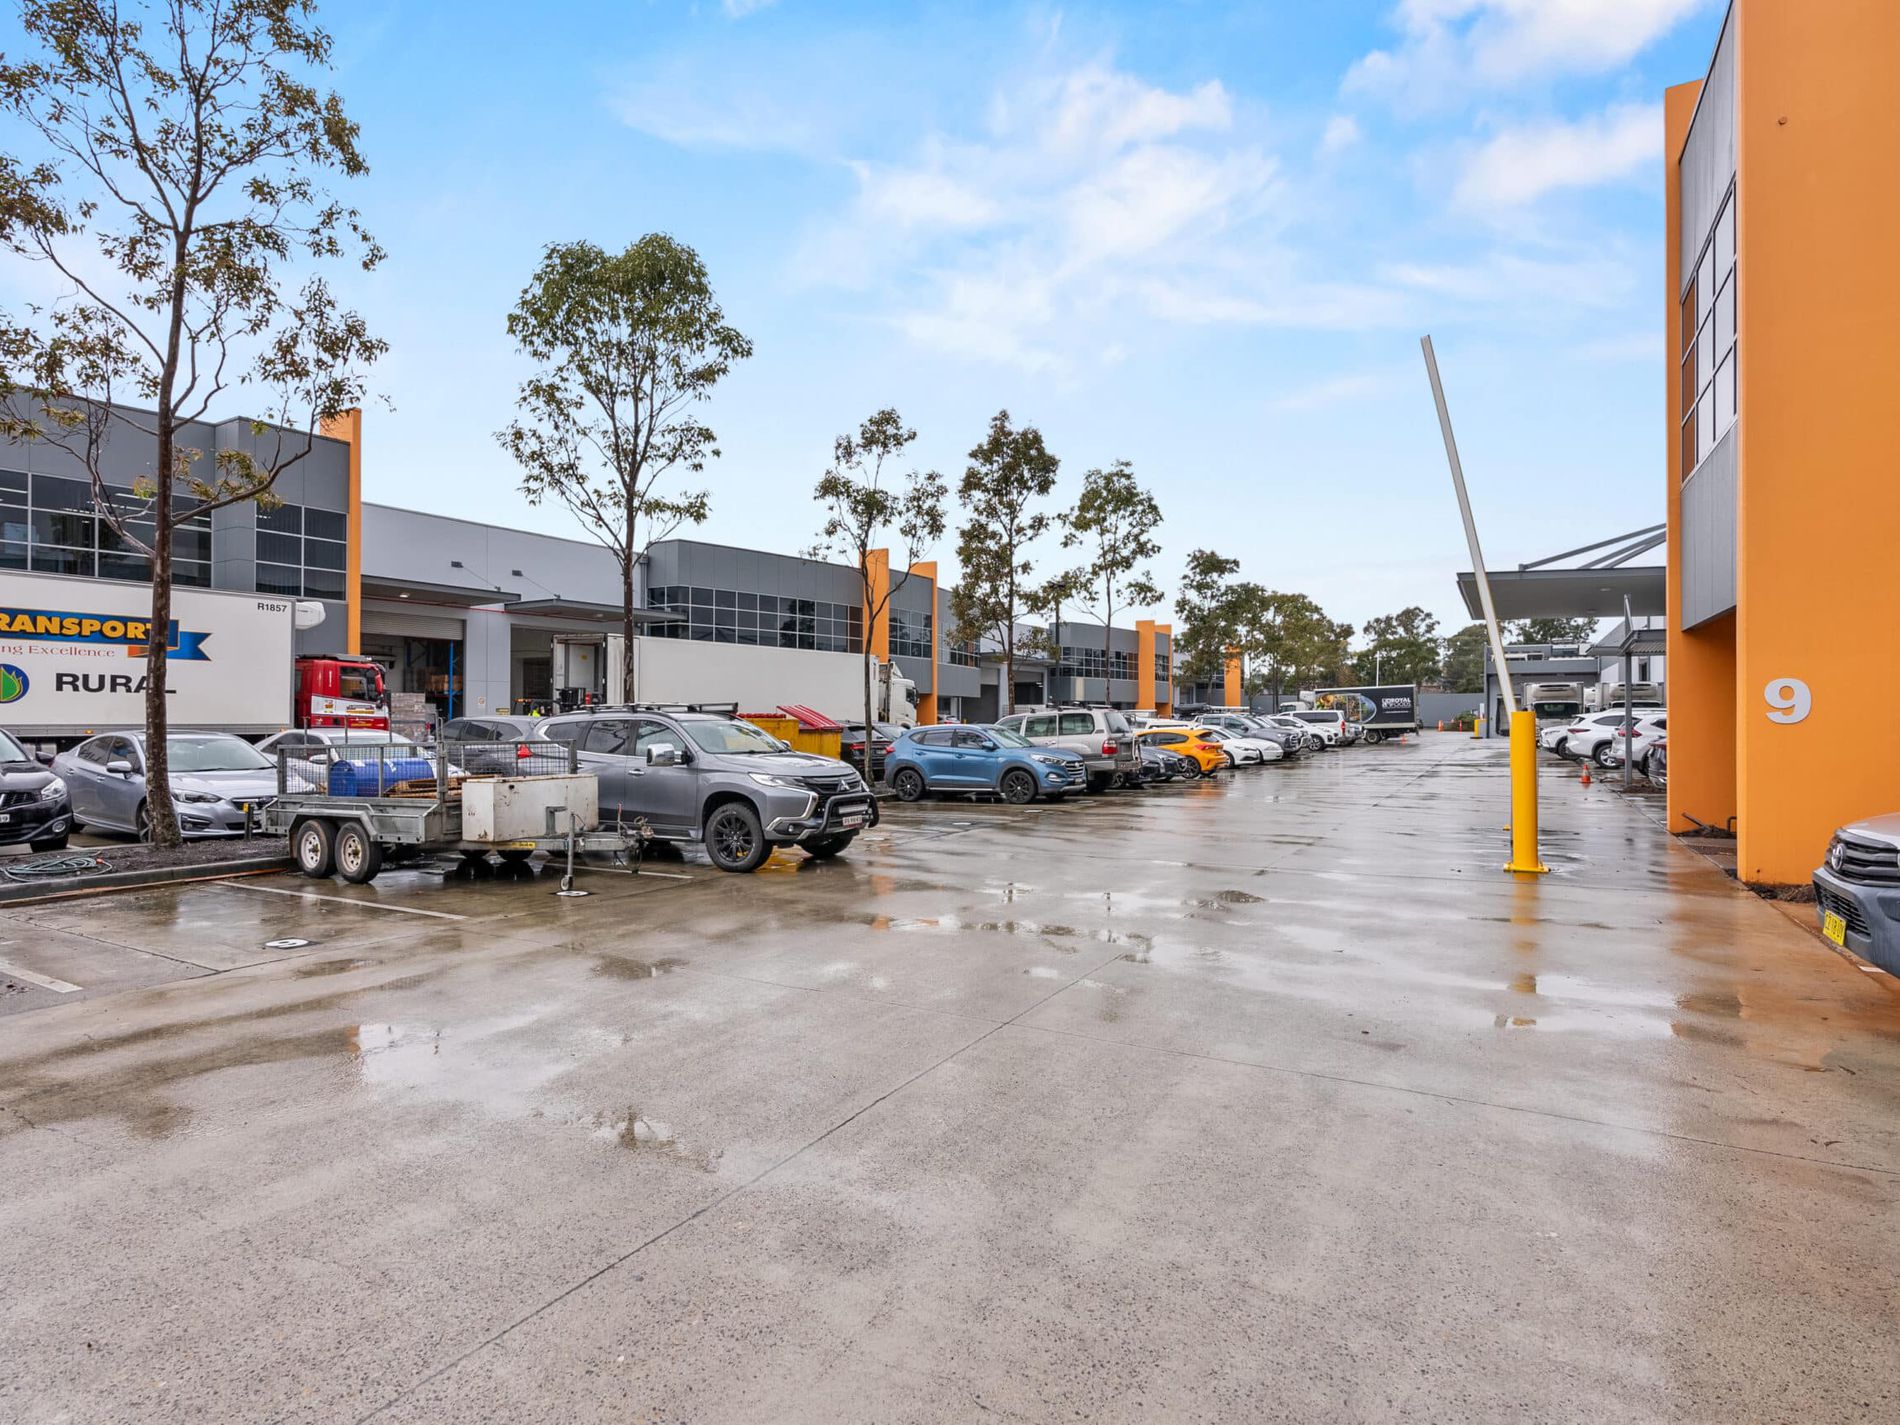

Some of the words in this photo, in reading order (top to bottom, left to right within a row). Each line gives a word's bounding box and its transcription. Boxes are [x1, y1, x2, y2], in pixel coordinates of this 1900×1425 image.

[257, 602, 287, 612] R1857
[0, 612, 151, 640] RANSPOR
[1, 645, 23, 655] ng
[28, 645, 115, 658] Excellence
[1764, 677, 1812, 724] 9
